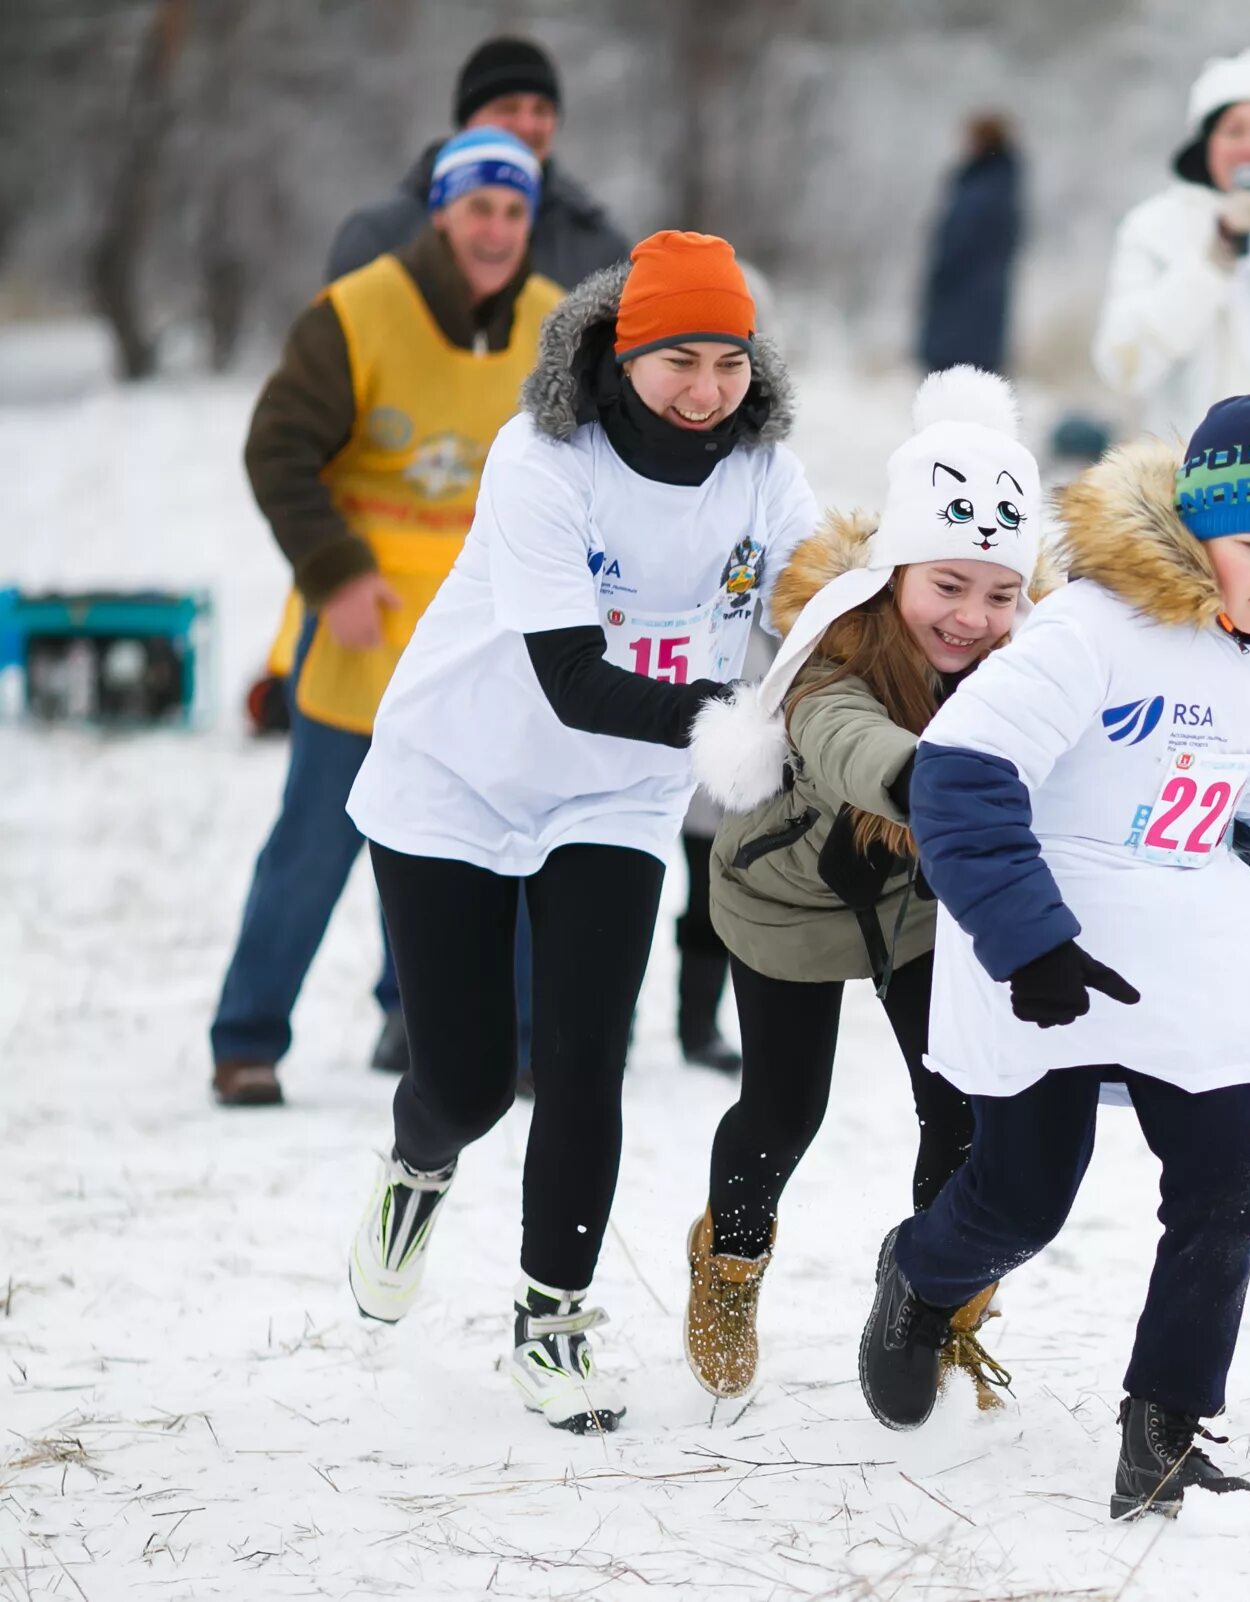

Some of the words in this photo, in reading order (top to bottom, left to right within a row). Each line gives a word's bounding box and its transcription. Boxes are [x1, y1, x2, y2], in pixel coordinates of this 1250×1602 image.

[603, 557, 621, 578] A
[629, 635, 690, 686] 15
[1172, 703, 1213, 727] RSA
[1144, 776, 1240, 853] 22
